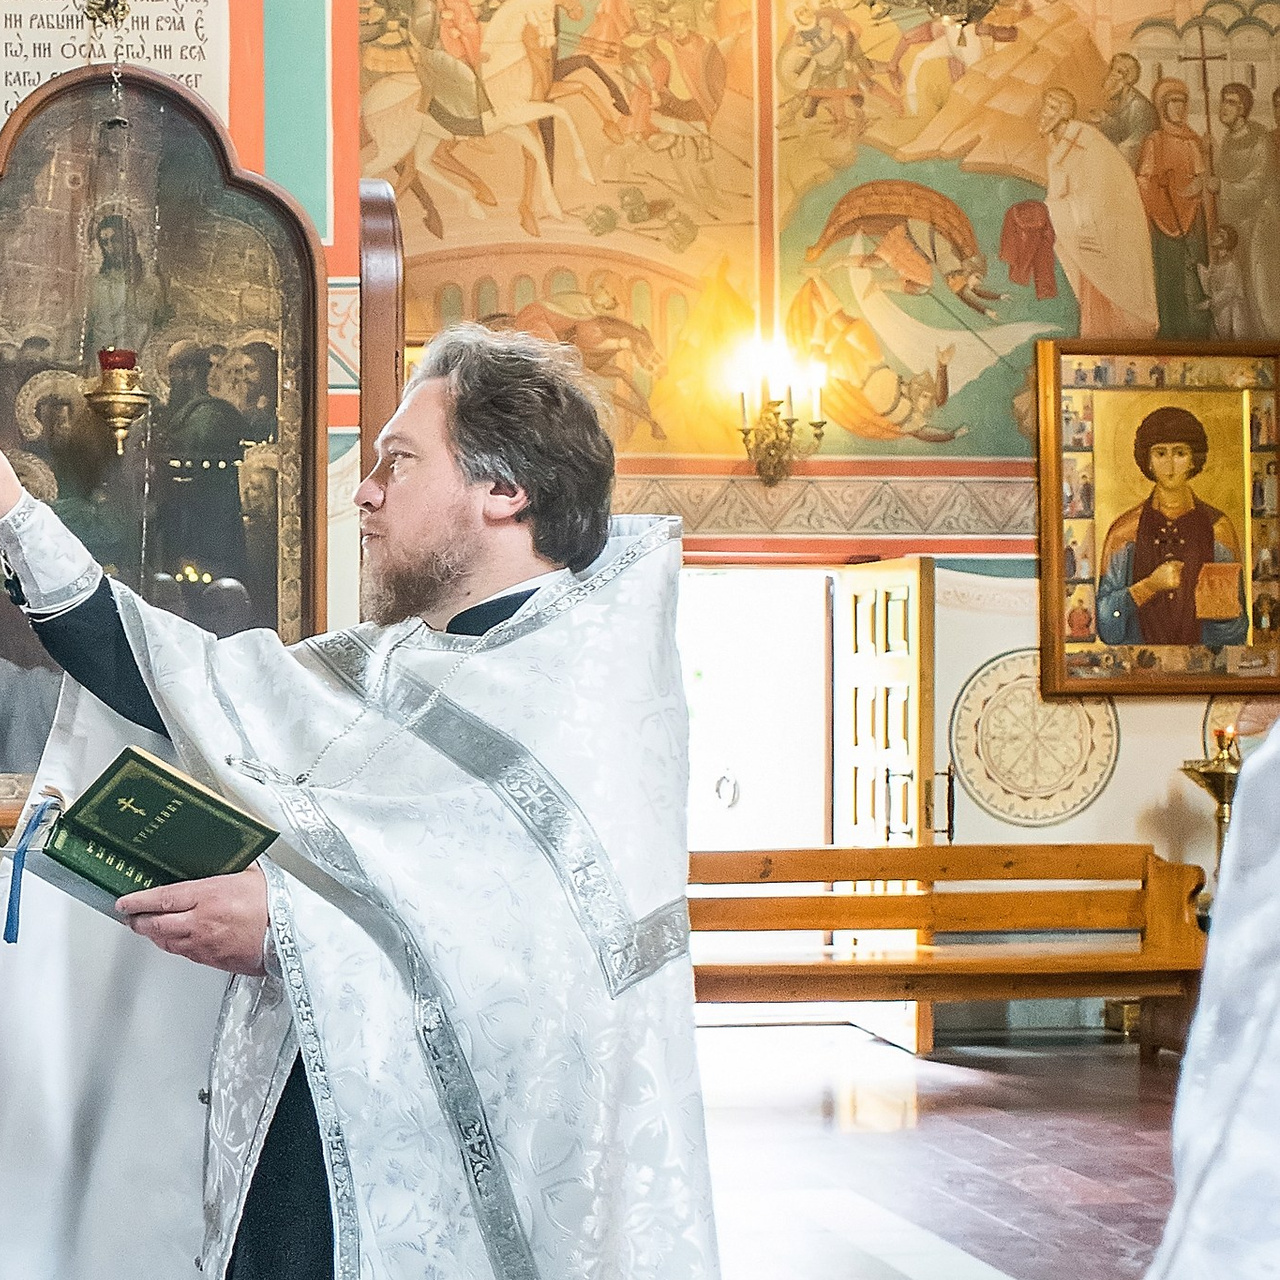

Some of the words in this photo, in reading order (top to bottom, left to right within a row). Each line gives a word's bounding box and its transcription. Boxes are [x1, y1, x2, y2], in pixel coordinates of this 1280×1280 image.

[4, 13, 22, 29] ни
[131, 15, 149, 30] ни
[33, 42, 51, 58] ни
[154, 45, 172, 59] ни
